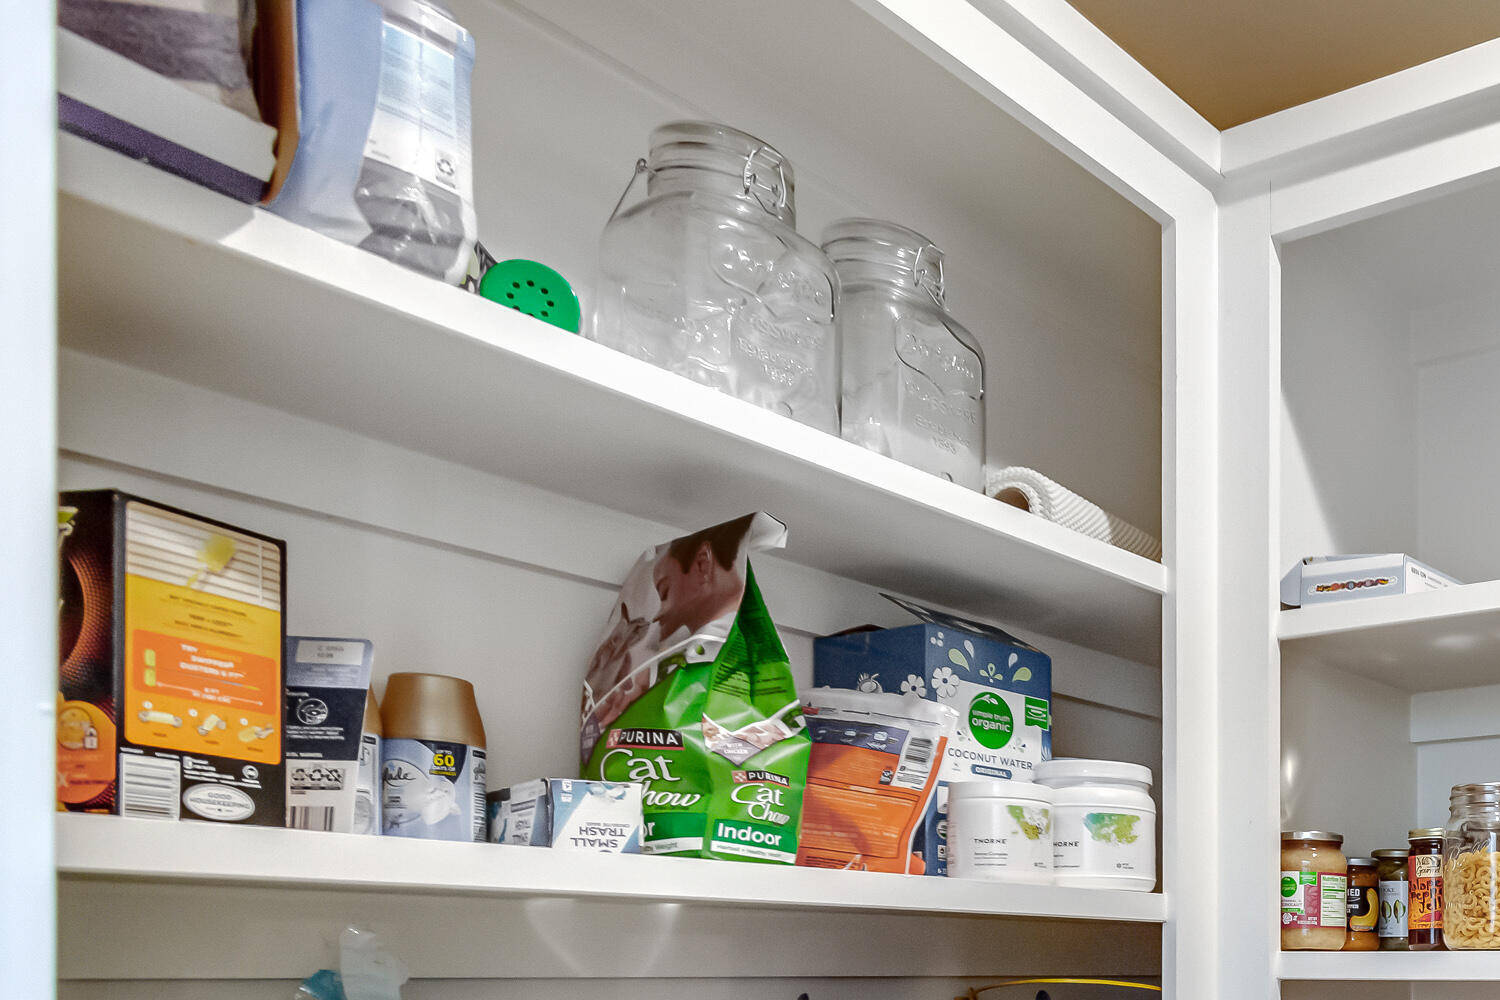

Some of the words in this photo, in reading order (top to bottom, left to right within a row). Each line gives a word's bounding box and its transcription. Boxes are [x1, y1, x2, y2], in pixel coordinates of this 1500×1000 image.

[971, 717, 1011, 734] organic
[620, 730, 680, 746] PURINA
[432, 753, 455, 767] 60
[600, 748, 681, 783] Cat
[947, 748, 997, 765] COCONUT
[999, 757, 1033, 771] WATER
[748, 771, 790, 786] PURINA
[641, 780, 702, 807] how
[730, 783, 785, 807] Cat
[746, 802, 791, 825] Chow
[578, 826, 627, 837] TRASH
[717, 822, 782, 847] Indoor
[569, 837, 619, 848] SMALL
